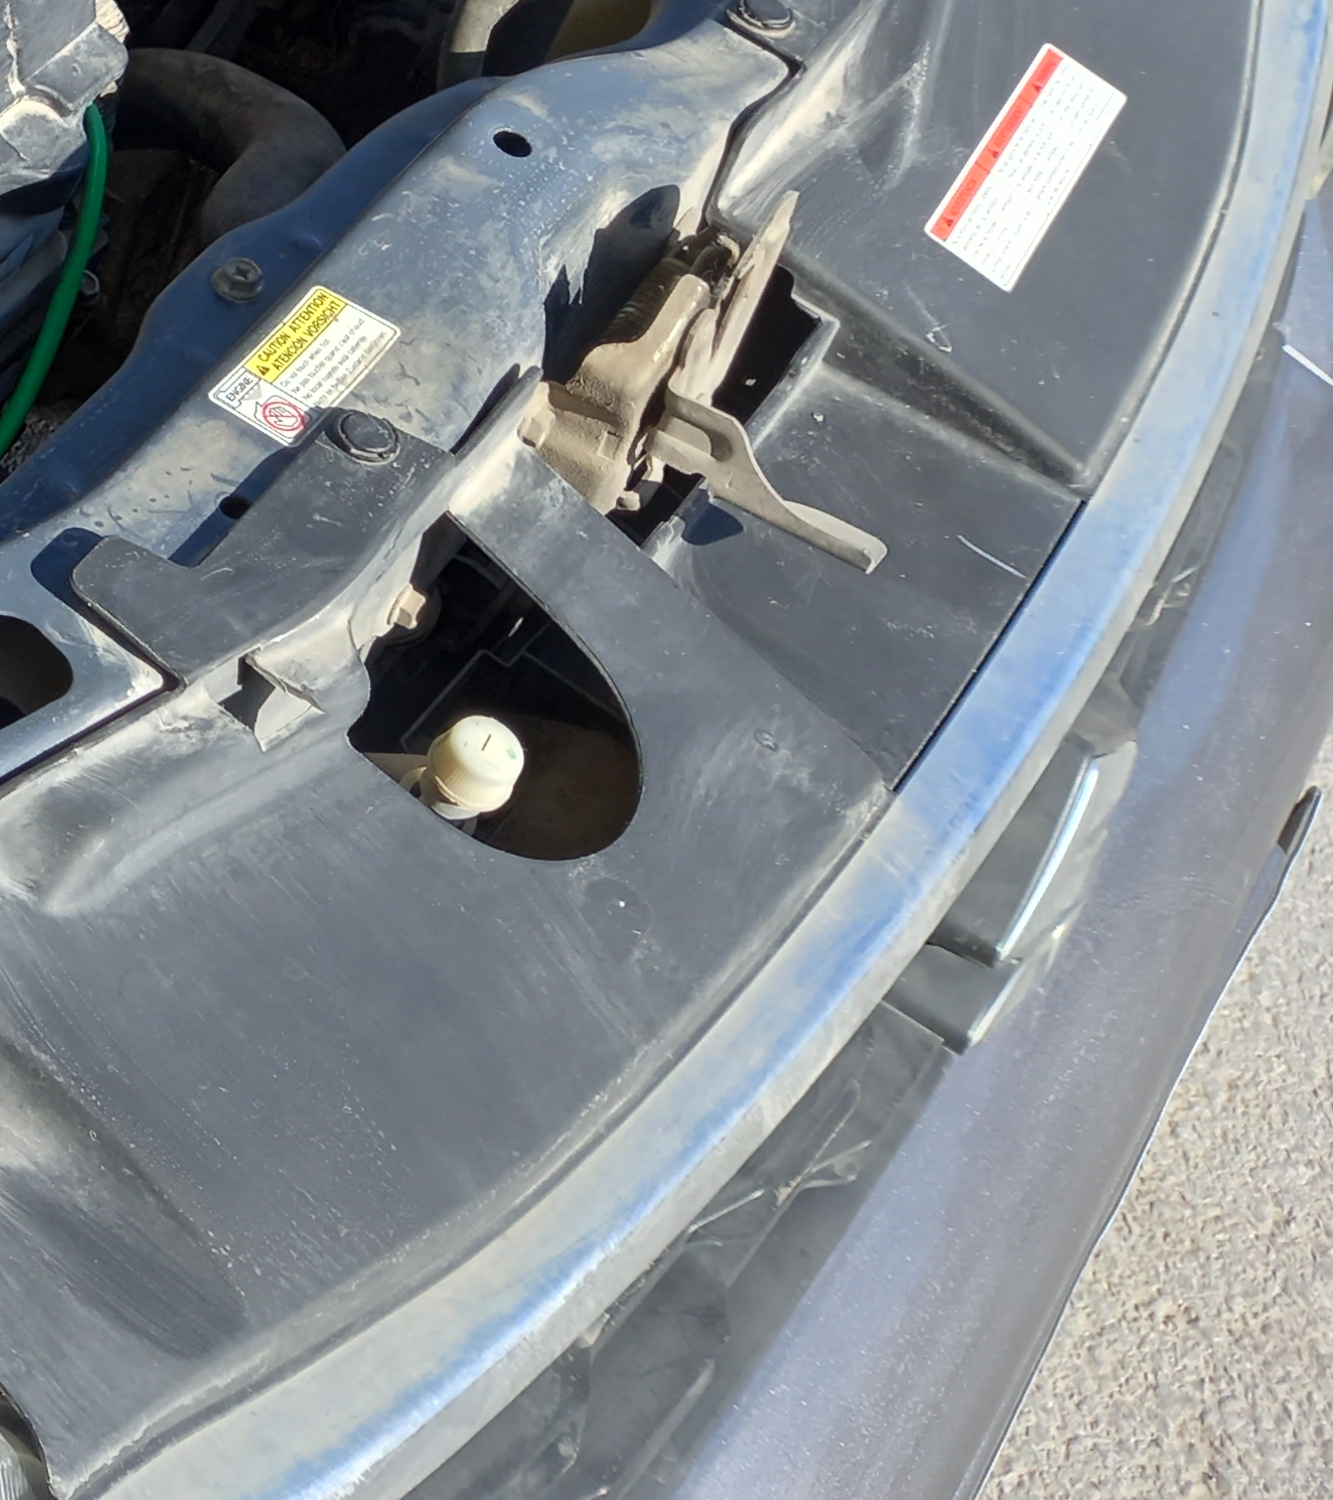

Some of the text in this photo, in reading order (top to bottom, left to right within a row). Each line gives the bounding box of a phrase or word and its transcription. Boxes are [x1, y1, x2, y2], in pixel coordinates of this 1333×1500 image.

[258, 292, 328, 362] CAUTION ATTENTION
[305, 300, 341, 338] VORSICHT
[226, 376, 254, 402] ENGINE
